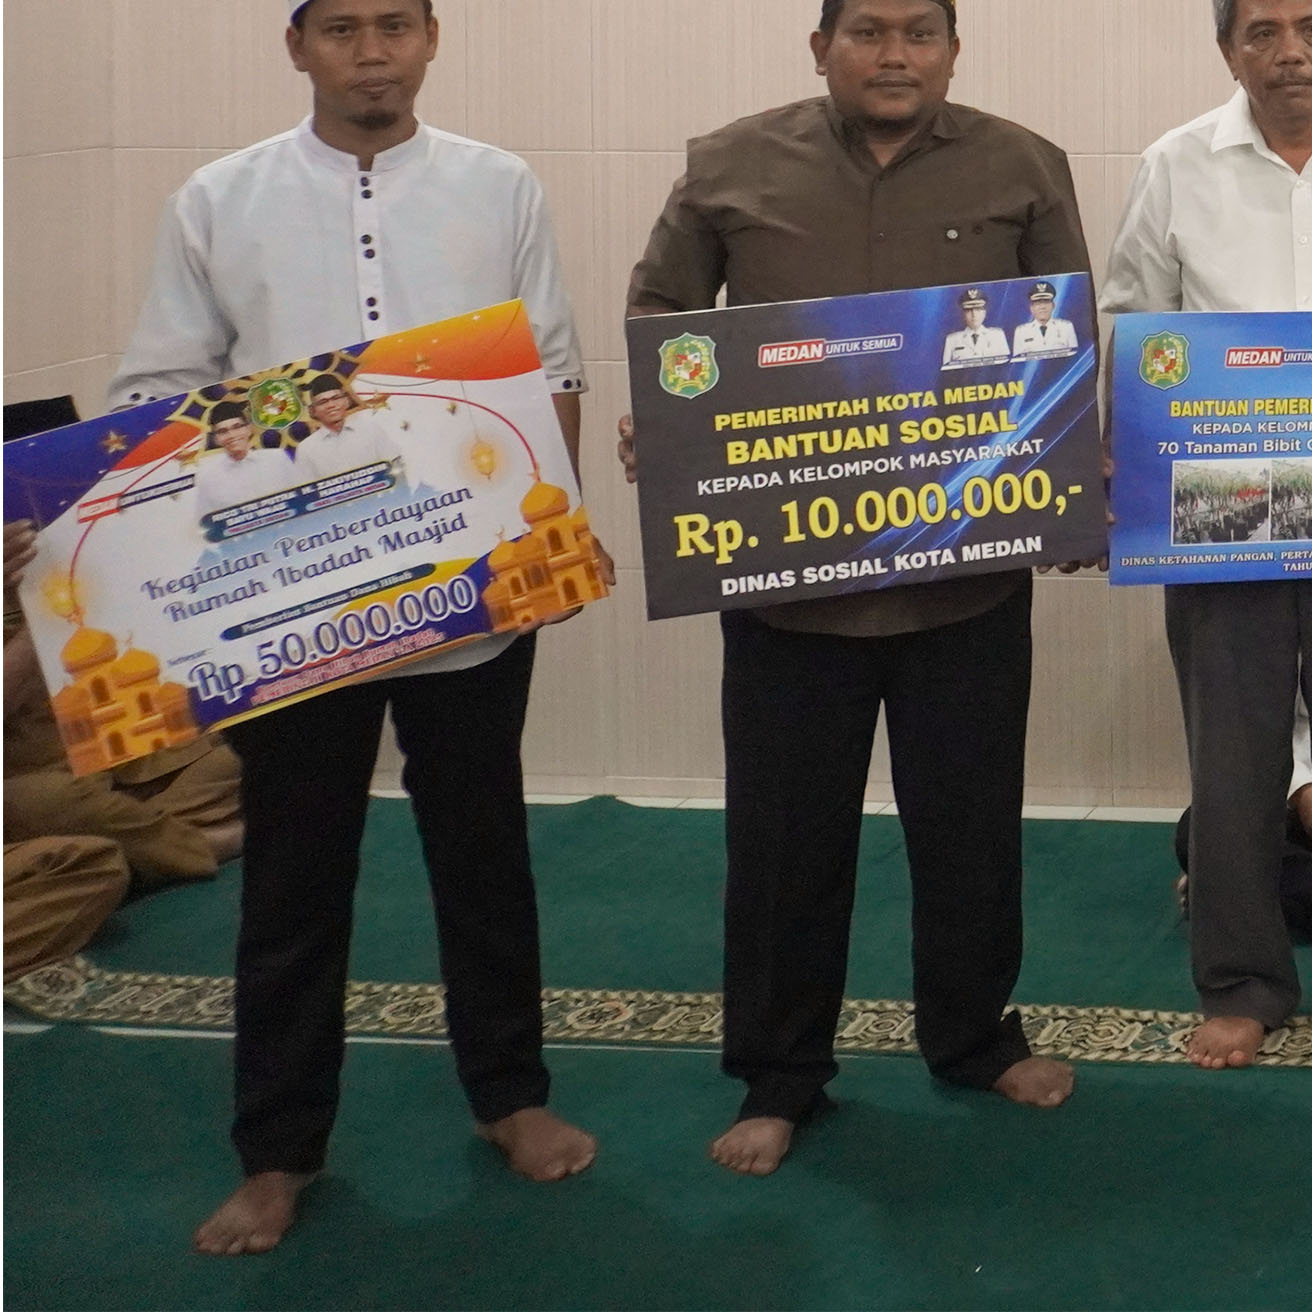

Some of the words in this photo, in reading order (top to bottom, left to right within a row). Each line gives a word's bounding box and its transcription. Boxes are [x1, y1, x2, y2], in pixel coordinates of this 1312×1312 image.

[760, 339, 824, 367] MEDAN
[825, 340, 861, 356] UNTUK
[861, 336, 897, 351] SEMUA
[1228, 350, 1282, 367] MEDAN
[714, 397, 870, 432] PEMERINTAH
[876, 392, 939, 417] KOTA
[943, 380, 1025, 407] MEDAN
[1169, 399, 1249, 418] BANTUAN
[1192, 421, 1253, 435] KEPADA
[726, 424, 889, 466] BANTUAN
[899, 409, 1019, 444] SOSIAL
[1157, 441, 1180, 456] 70
[1184, 440, 1258, 455] Tanaman
[1262, 437, 1302, 453] Bibit
[697, 471, 784, 496] KEPADA
[788, 456, 904, 484] KELOMPOK
[909, 438, 1044, 470] MASYARAKAT
[140, 549, 271, 602] Kegiatan
[273, 486, 474, 560] Pemberdayaan
[673, 511, 759, 566] Rp.
[780, 468, 1083, 546] 10.000.000,-
[162, 579, 269, 624] Rumah
[272, 543, 373, 589] Ibadah
[376, 511, 469, 556] Masjid
[721, 569, 797, 596] DINAS
[802, 558, 888, 585] SOSIAL
[894, 549, 957, 572] KOTA
[961, 536, 1043, 561] MEDAN
[1121, 555, 1156, 567] DINAS
[1158, 552, 1226, 566] KETAHANAN
[1230, 550, 1278, 563] PANGAN,
[187, 659, 246, 704] Rp
[255, 574, 477, 679] 50.000.000
